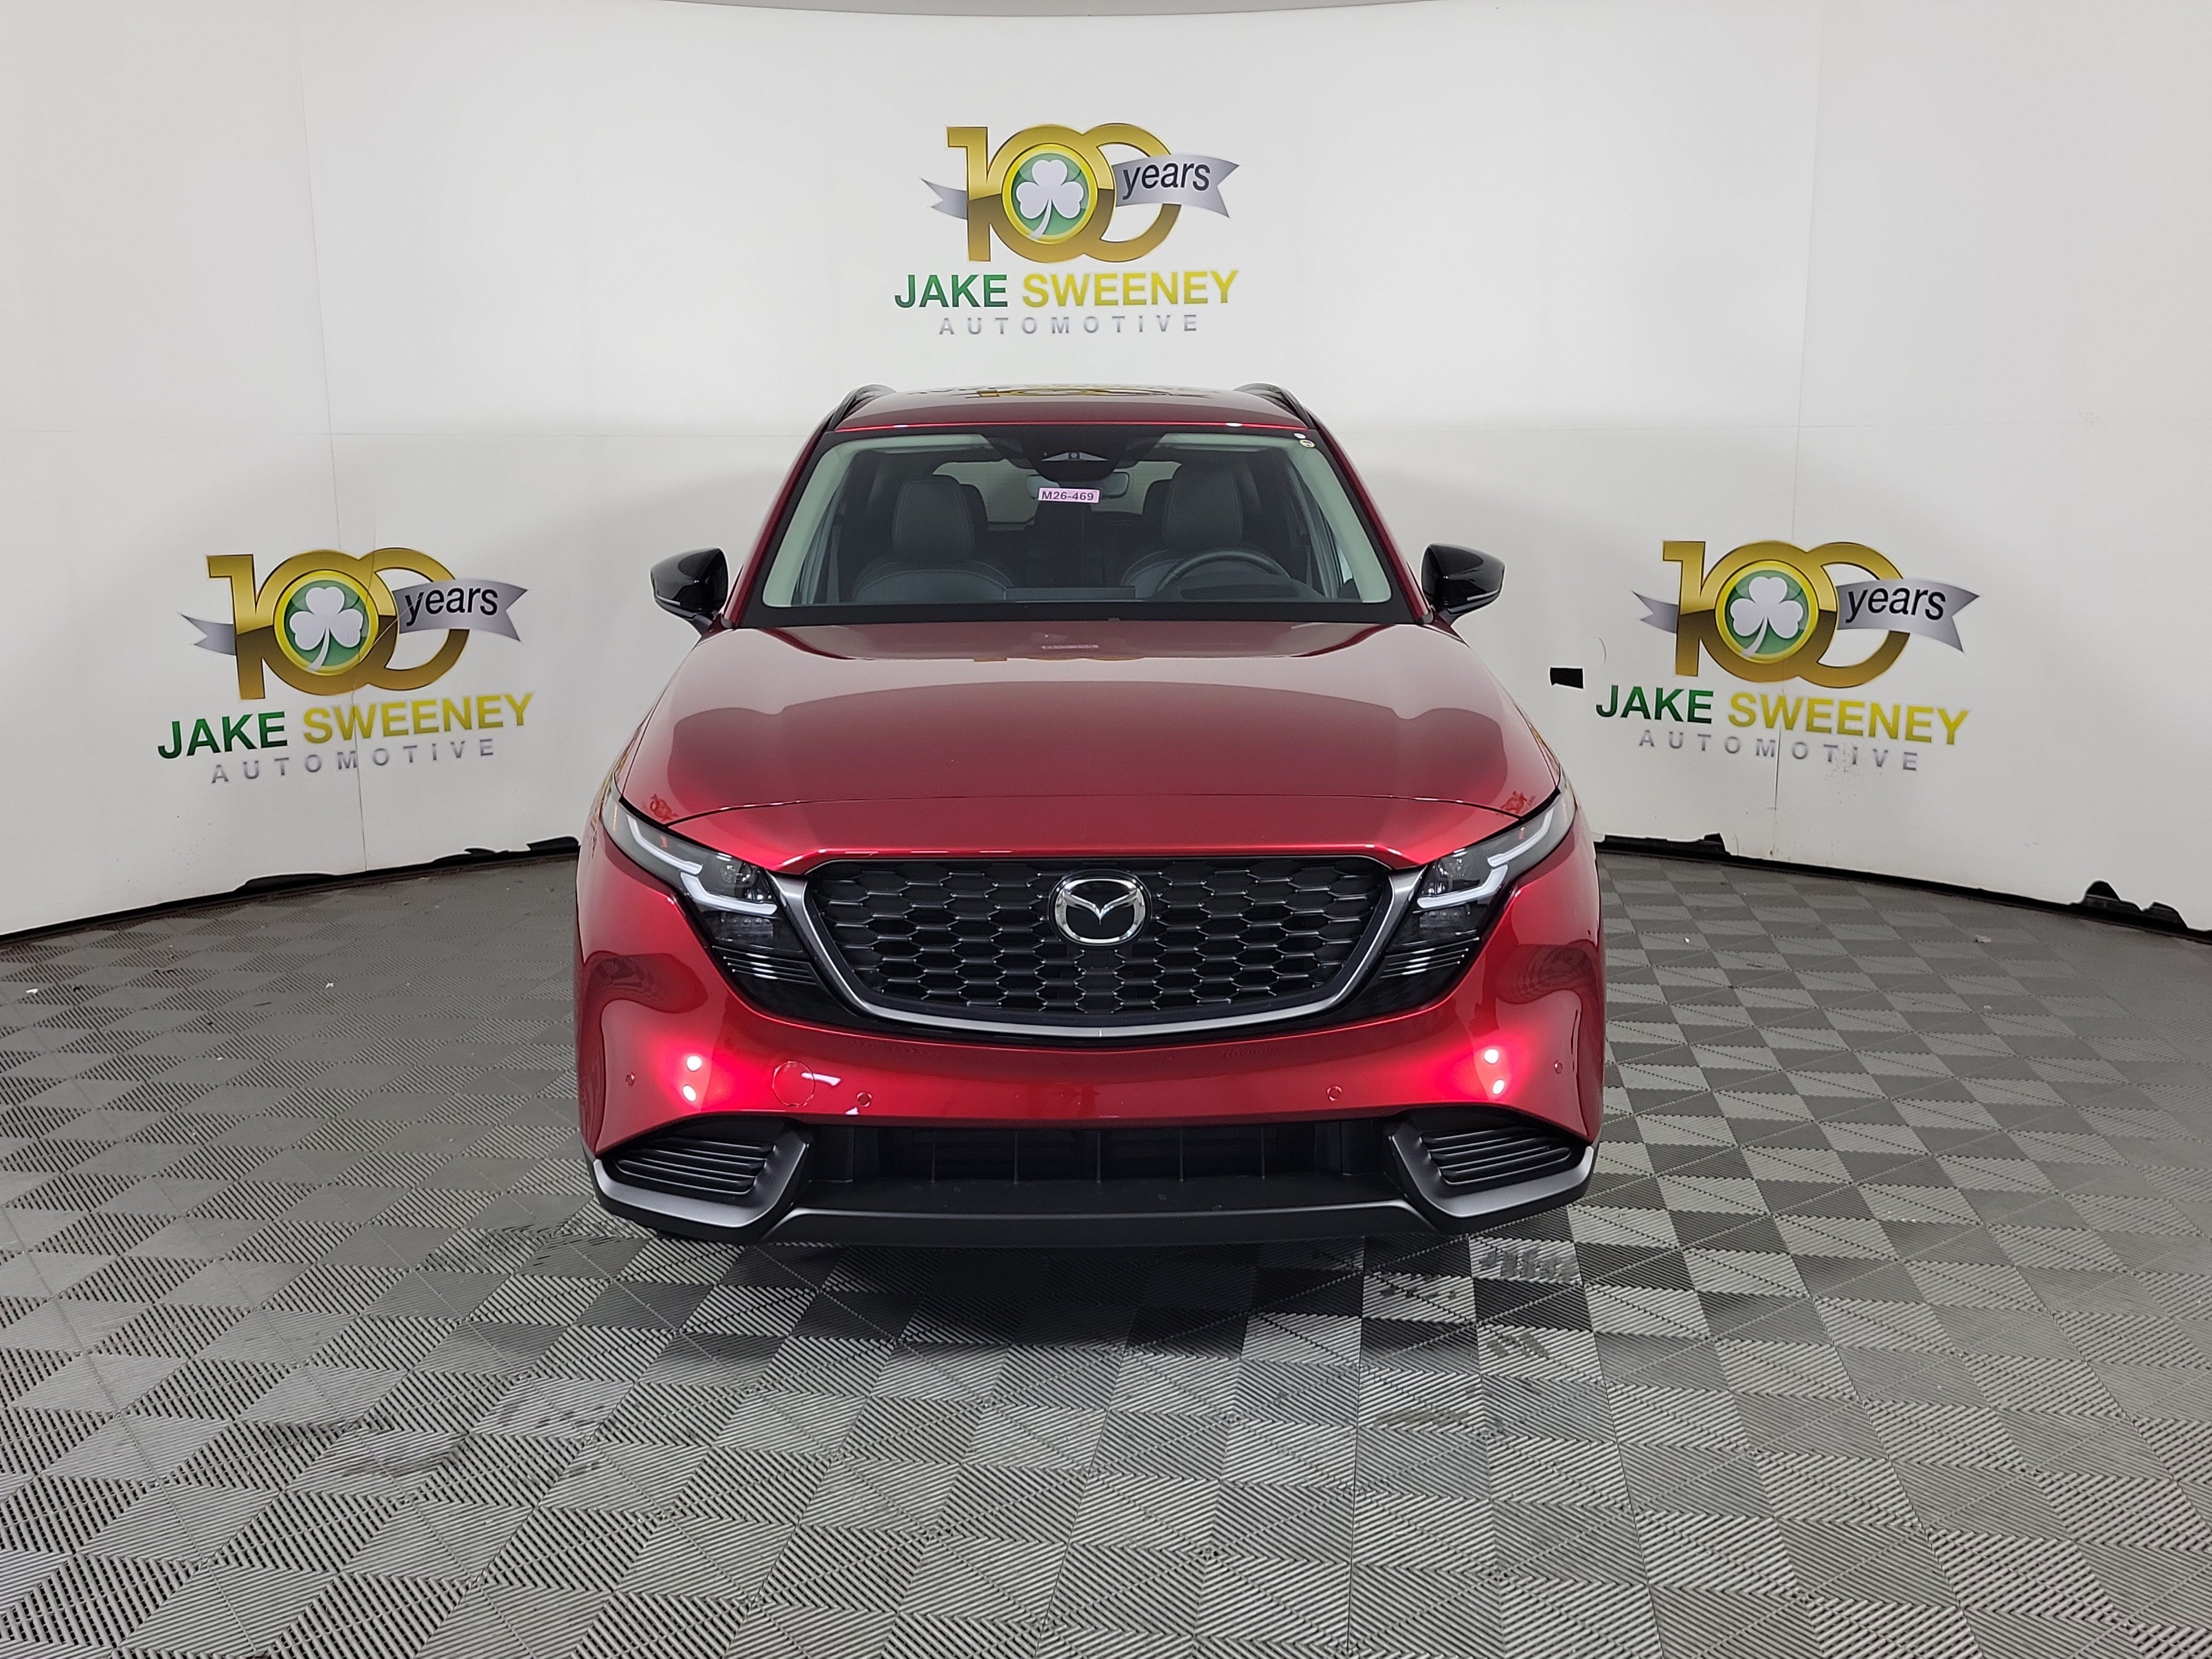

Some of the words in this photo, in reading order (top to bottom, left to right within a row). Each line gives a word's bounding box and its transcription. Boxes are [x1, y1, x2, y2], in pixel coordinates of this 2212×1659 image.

[946, 122, 1181, 263] 100
[1121, 162, 1210, 200] years
[894, 274, 1008, 308] JAKE
[1022, 270, 1238, 307] SWEENEY
[939, 314, 1197, 335] AUTOMOTIVE
[1042, 490, 1094, 500] M26-469
[207, 548, 470, 700] 100
[405, 586, 498, 625] years
[1662, 540, 1911, 689] 100
[1845, 585, 1946, 623] years
[158, 711, 287, 759] JAKE
[303, 692, 533, 743] SWEENEY
[1595, 685, 1714, 724] JAKE
[1728, 692, 1968, 745] SWEENEY
[211, 739, 494, 783] AUTOMOTIVE
[1639, 730, 1917, 770] AUTOMOTIVE
